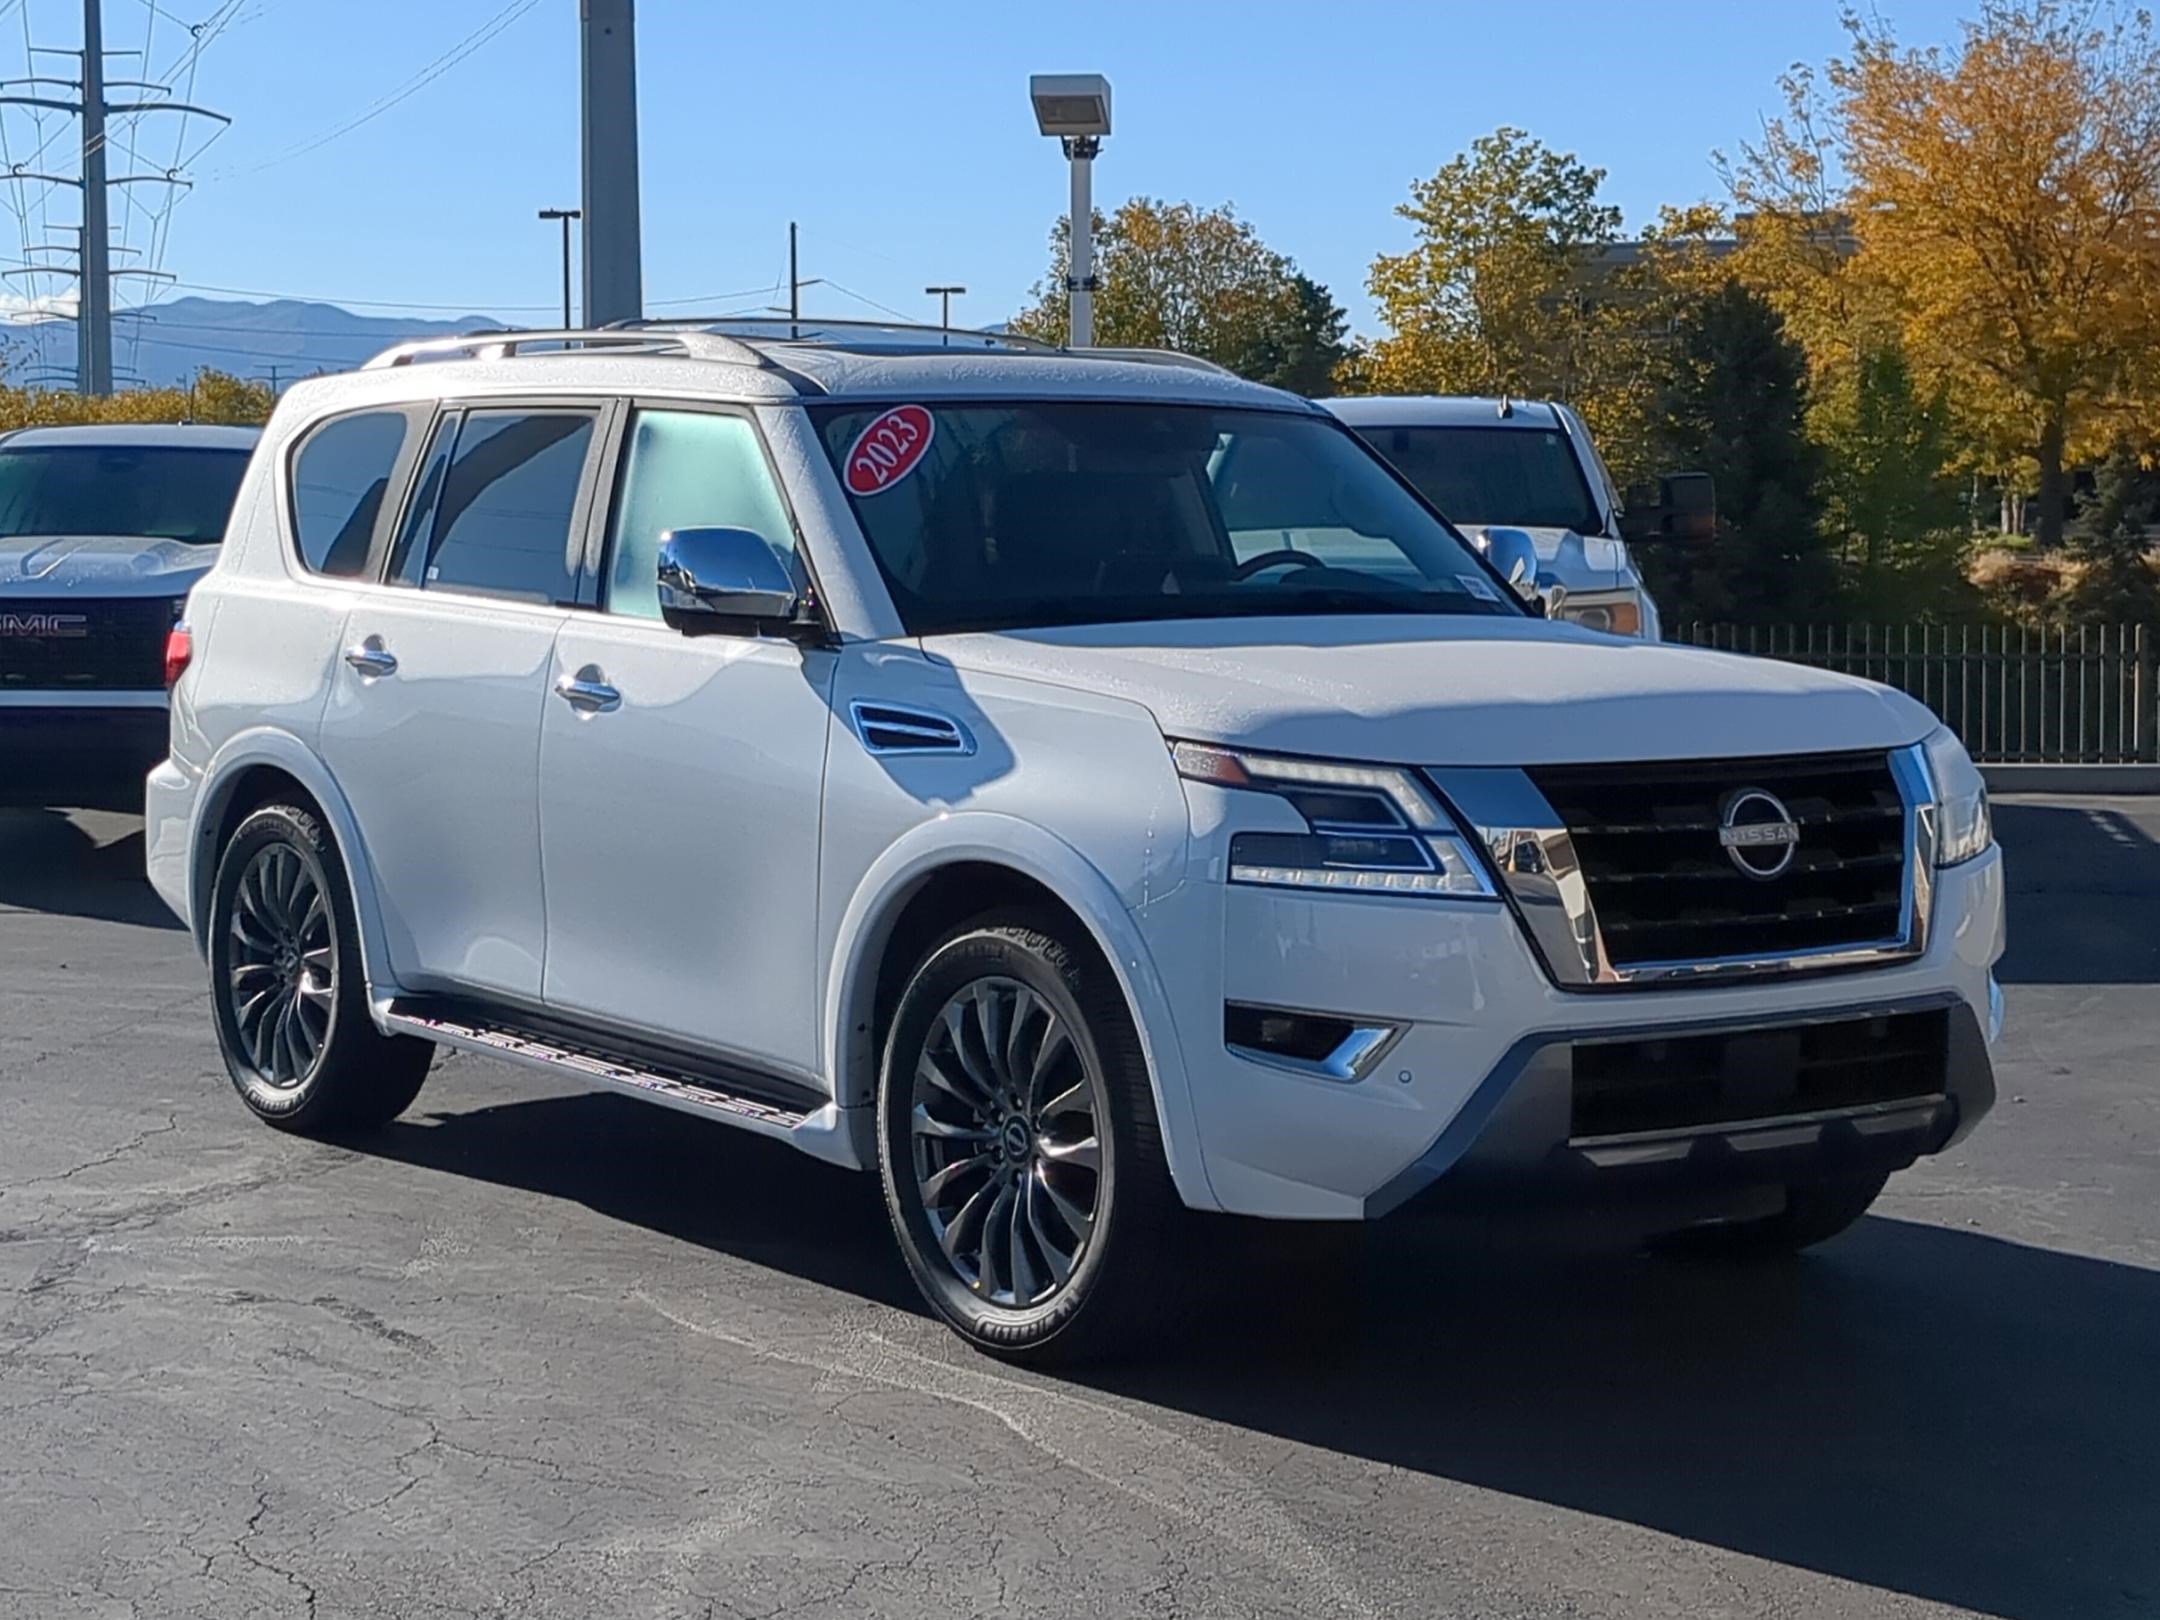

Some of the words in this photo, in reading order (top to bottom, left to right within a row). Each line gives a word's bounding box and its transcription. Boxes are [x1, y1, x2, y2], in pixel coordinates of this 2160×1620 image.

[856, 415, 918, 484] 2023
[0, 614, 87, 638] MC
[1722, 825, 1799, 843] NISSAN
